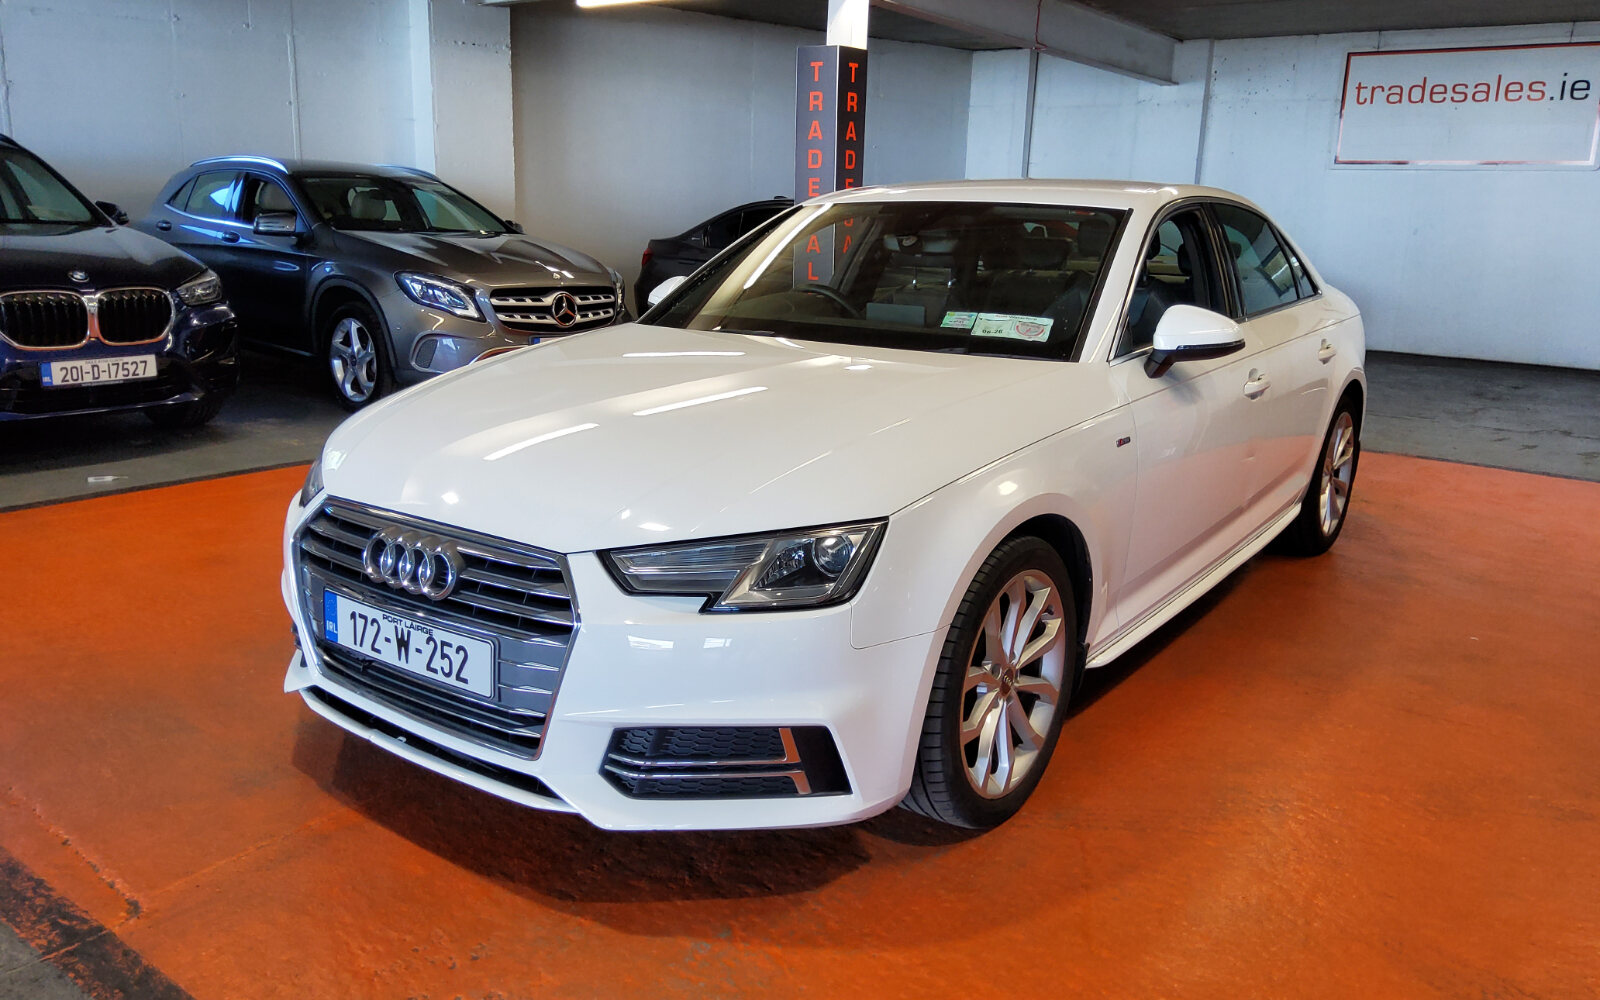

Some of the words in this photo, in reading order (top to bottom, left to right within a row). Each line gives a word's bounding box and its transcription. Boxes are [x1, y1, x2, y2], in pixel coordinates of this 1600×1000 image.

[1355, 73, 1591, 105] tradesales.ie
[60, 360, 148, 383] 201-D-17527
[326, 620, 338, 634] IRL
[382, 613, 403, 627] PORT
[350, 610, 469, 685] 172-W-252
